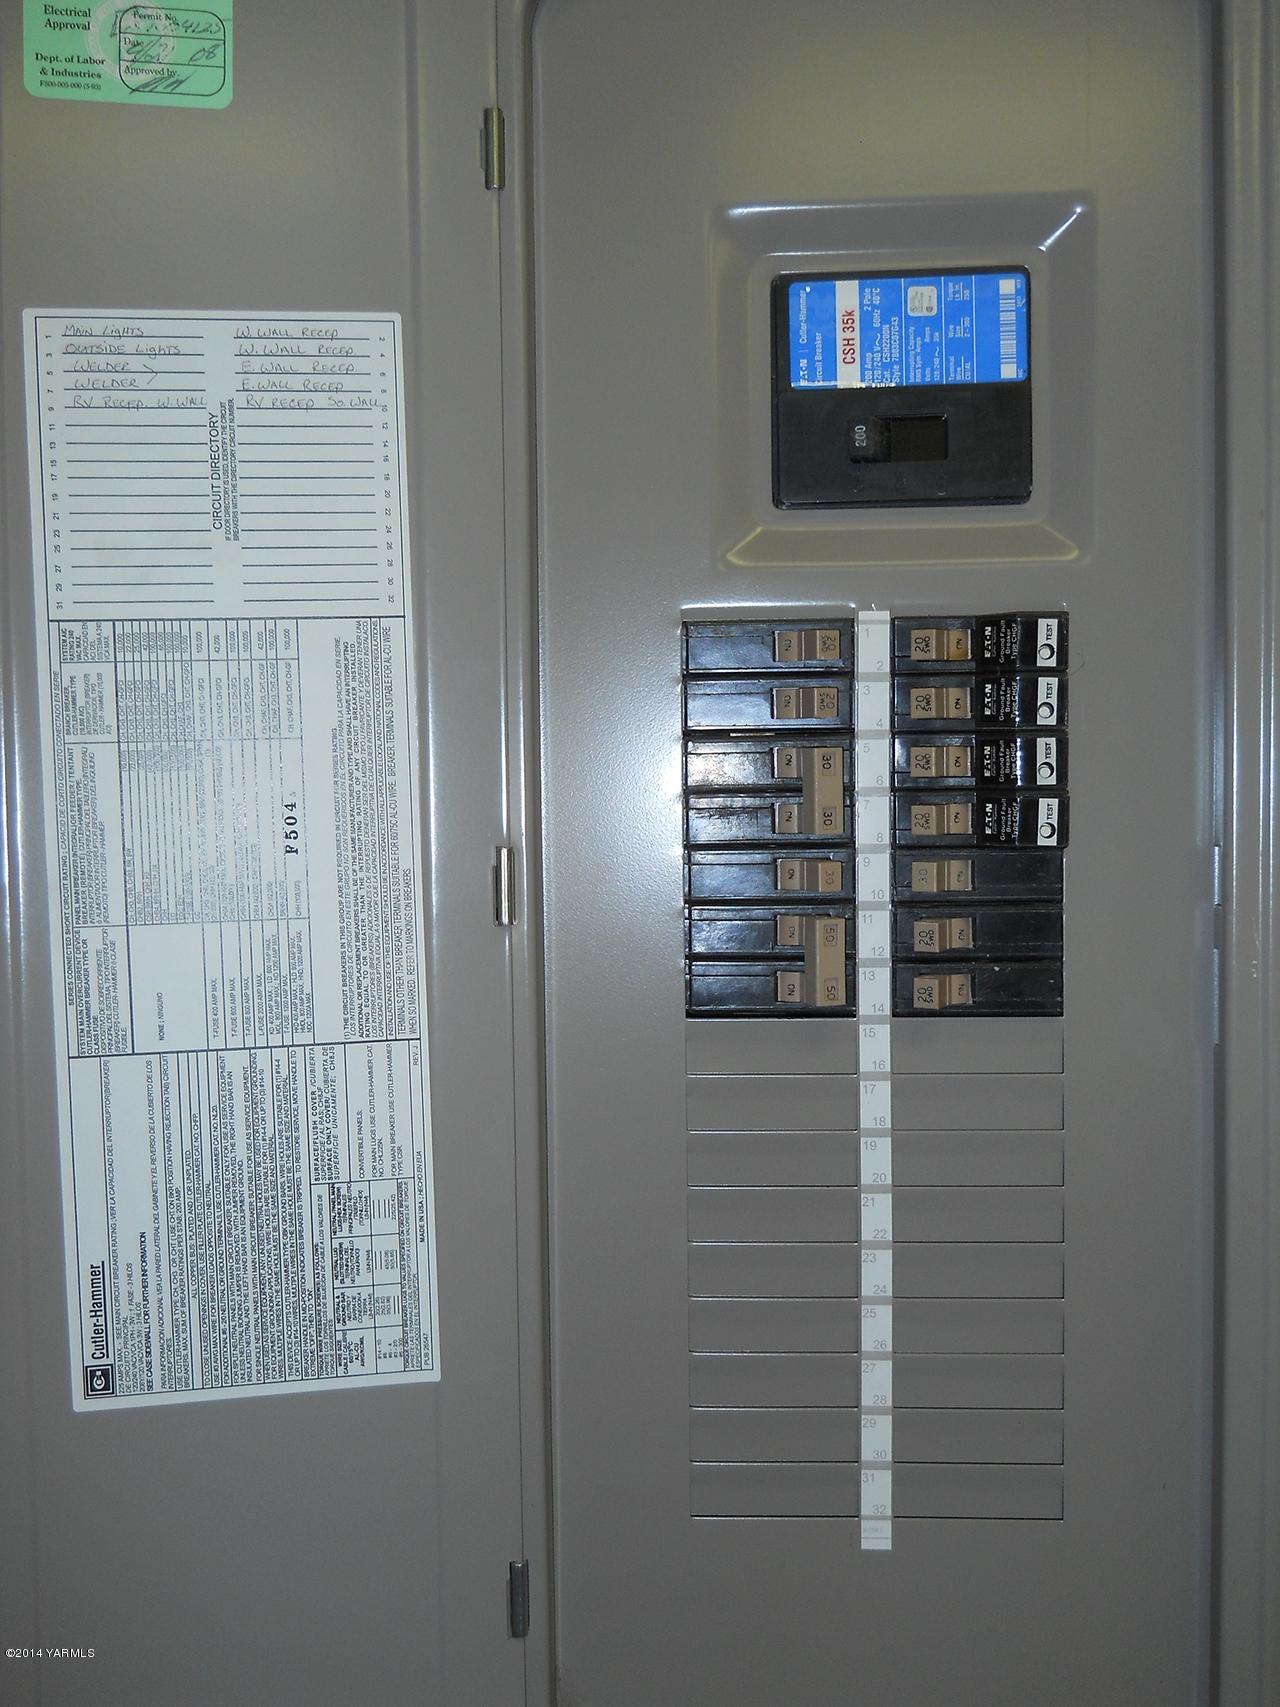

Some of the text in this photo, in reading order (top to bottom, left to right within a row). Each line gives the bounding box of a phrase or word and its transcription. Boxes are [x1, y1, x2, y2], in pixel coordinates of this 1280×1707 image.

[44, 4, 91, 17] Electrical
[133, 8, 161, 21] Permit
[45, 19, 91, 31] Approval
[123, 37, 144, 47] Date
[35, 52, 106, 65] Dept. of Labor
[40, 67, 101, 78] & Industries
[124, 65, 164, 76] Approved
[799, 290, 807, 344] Cutler-Hammer
[842, 310, 855, 364] CSH 35k
[865, 353, 873, 368] Amp
[73, 395, 93, 408] RV
[246, 394, 264, 408] RV
[856, 425, 866, 447] 200
[208, 412, 222, 530] CIRCUIT DIRECTORY
[865, 629, 870, 639] 1
[915, 636, 924, 654] 20
[955, 638, 962, 650] ON
[877, 661, 884, 671] 2
[863, 685, 870, 696] 3
[916, 694, 925, 711] 20
[954, 697, 962, 710] ON
[876, 718, 883, 728] 4
[863, 743, 870, 753] 5
[822, 754, 832, 770] 30
[914, 753, 924, 770] 20
[954, 756, 961, 768] ON
[876, 775, 884, 786] 6
[863, 800, 870, 810] 7
[823, 811, 833, 827] 30
[914, 812, 924, 829] 20
[953, 812, 960, 824] ON
[876, 832, 884, 843] 8
[863, 857, 870, 867] 9
[871, 890, 885, 900] 10
[64, 912, 72, 935] SHORT
[863, 914, 873, 924] 11
[919, 930, 928, 946] 20
[871, 947, 885, 957] 12
[65, 937, 73, 980] CONNECTED
[862, 971, 875, 981] 13
[786, 983, 795, 997] ON
[917, 987, 927, 1003] 20
[871, 1004, 885, 1014] 14
[863, 1027, 876, 1038] 15
[872, 1060, 886, 1070] 16
[863, 1084, 876, 1095] 17
[873, 1117, 887, 1127] 18
[312, 1120, 320, 1181] SURFACE/FLUSH
[863, 1140, 877, 1151] 19
[872, 1173, 887, 1183] 20
[862, 1197, 875, 1207] 21
[873, 1229, 887, 1239] 22
[862, 1253, 877, 1263] 23
[873, 1284, 887, 1295] 24
[89, 1264, 105, 1360] Cutler-Hammer
[862, 1308, 877, 1318] 25
[873, 1340, 887, 1350] 26
[862, 1363, 877, 1373] 27
[873, 1395, 887, 1405] 28
[862, 1418, 877, 1428] 29
[873, 1450, 887, 1460] 30
[862, 1473, 875, 1483] 31
[872, 1505, 887, 1515] 32
